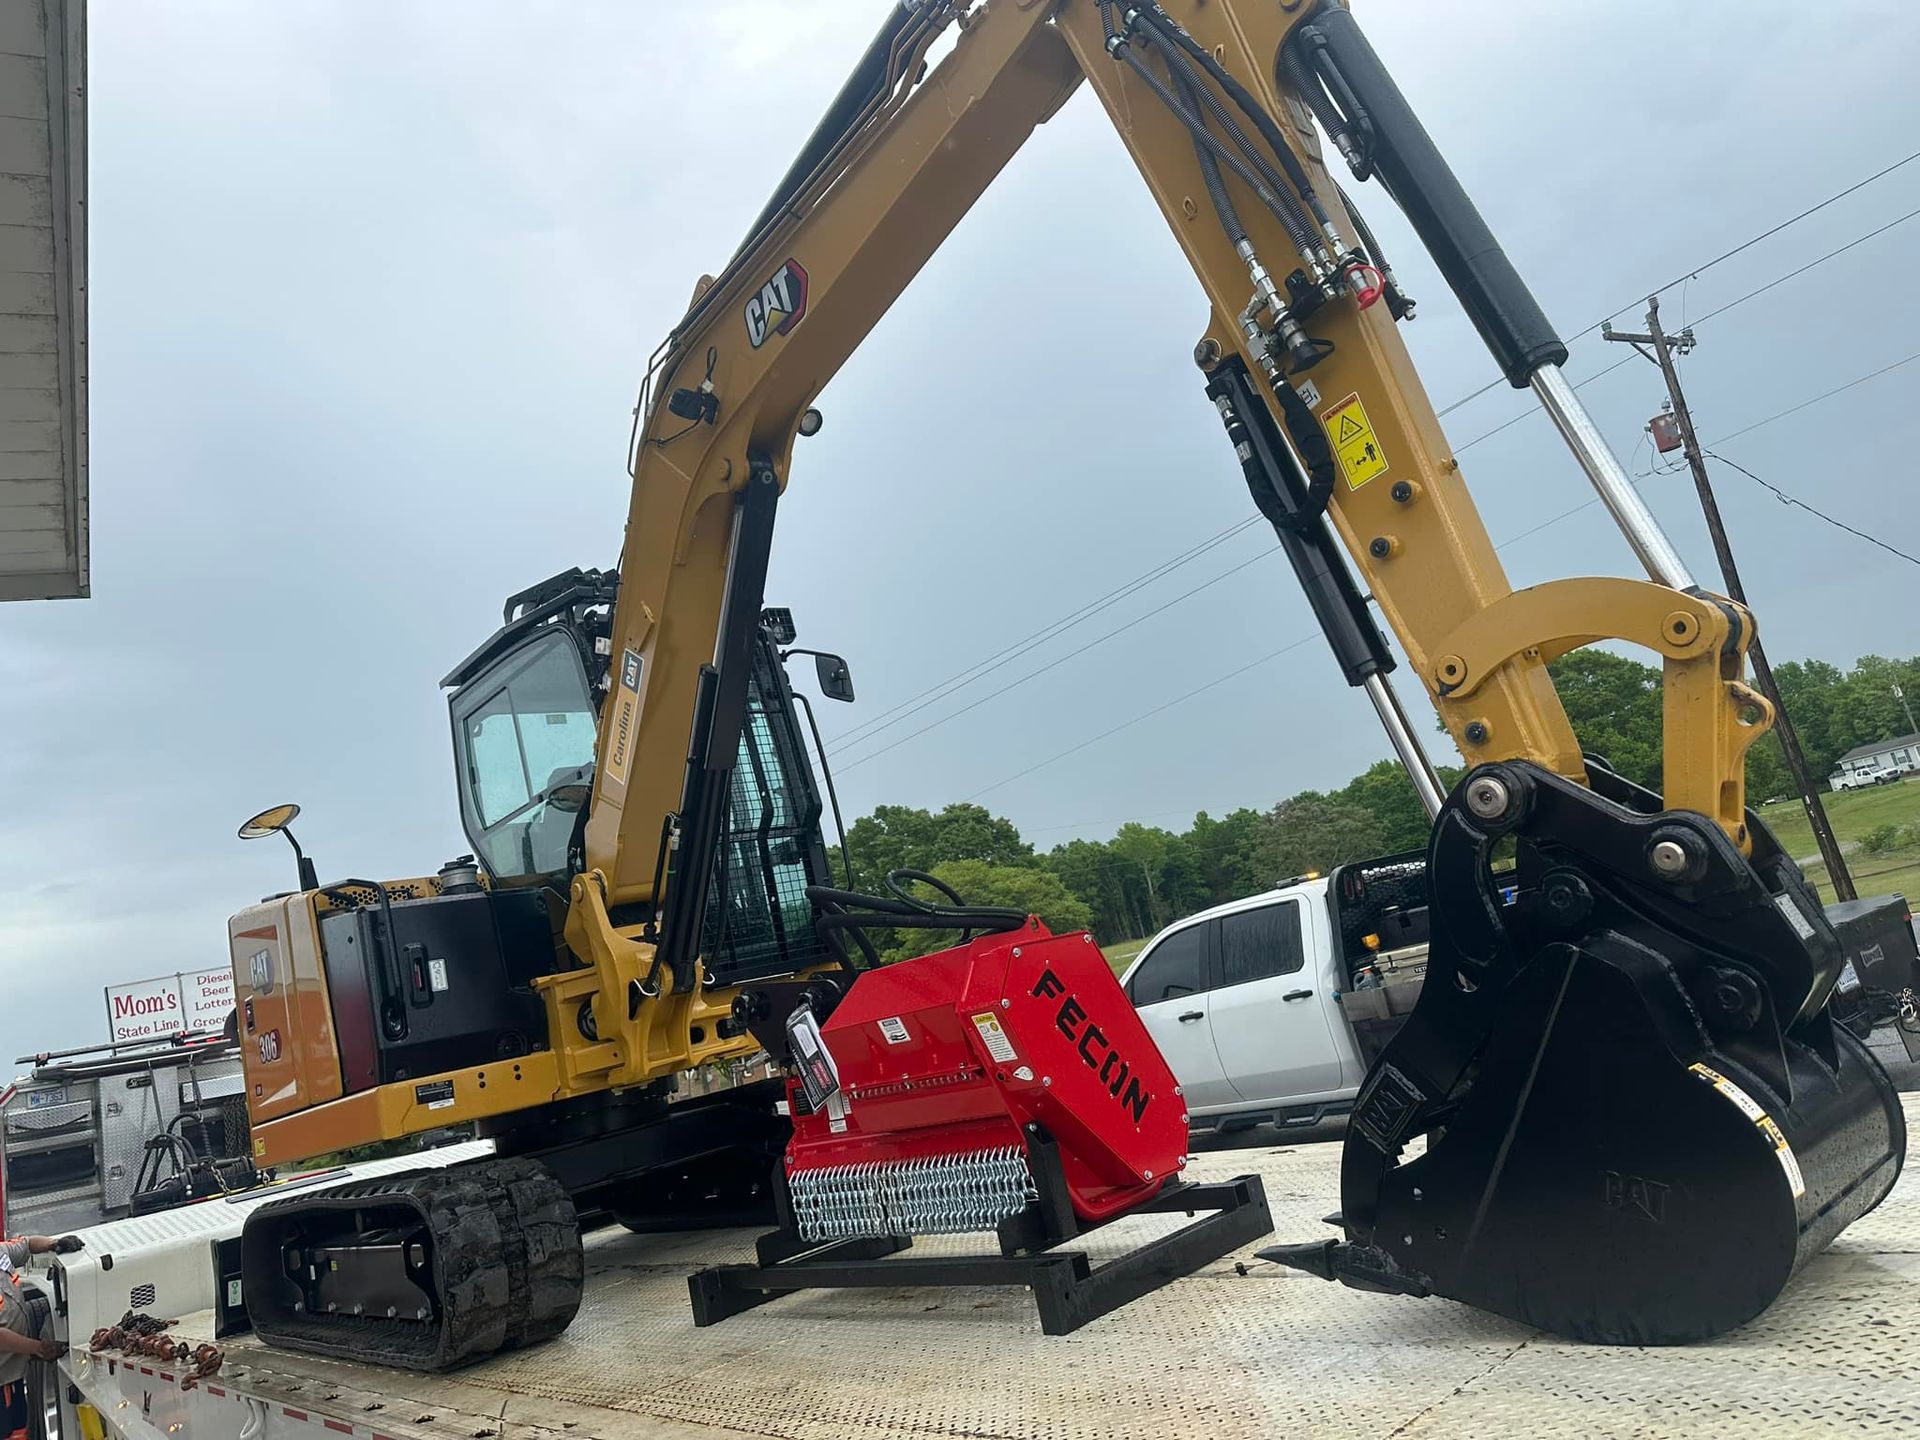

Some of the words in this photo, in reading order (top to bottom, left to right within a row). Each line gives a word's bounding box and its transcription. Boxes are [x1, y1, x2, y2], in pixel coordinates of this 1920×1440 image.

[745, 265, 793, 347] CAT
[614, 702, 631, 767] Carolina
[625, 657, 639, 688] CAT
[196, 971, 233, 985] Diesel
[249, 951, 268, 989] CAT
[114, 988, 177, 1019] Mom's
[201, 985, 230, 997] Beer
[117, 1025, 151, 1039] State
[153, 1019, 180, 1032] Line
[259, 1030, 278, 1064] 306
[1033, 969, 1149, 1123] FECON
[1604, 1168, 1671, 1222] CAT
